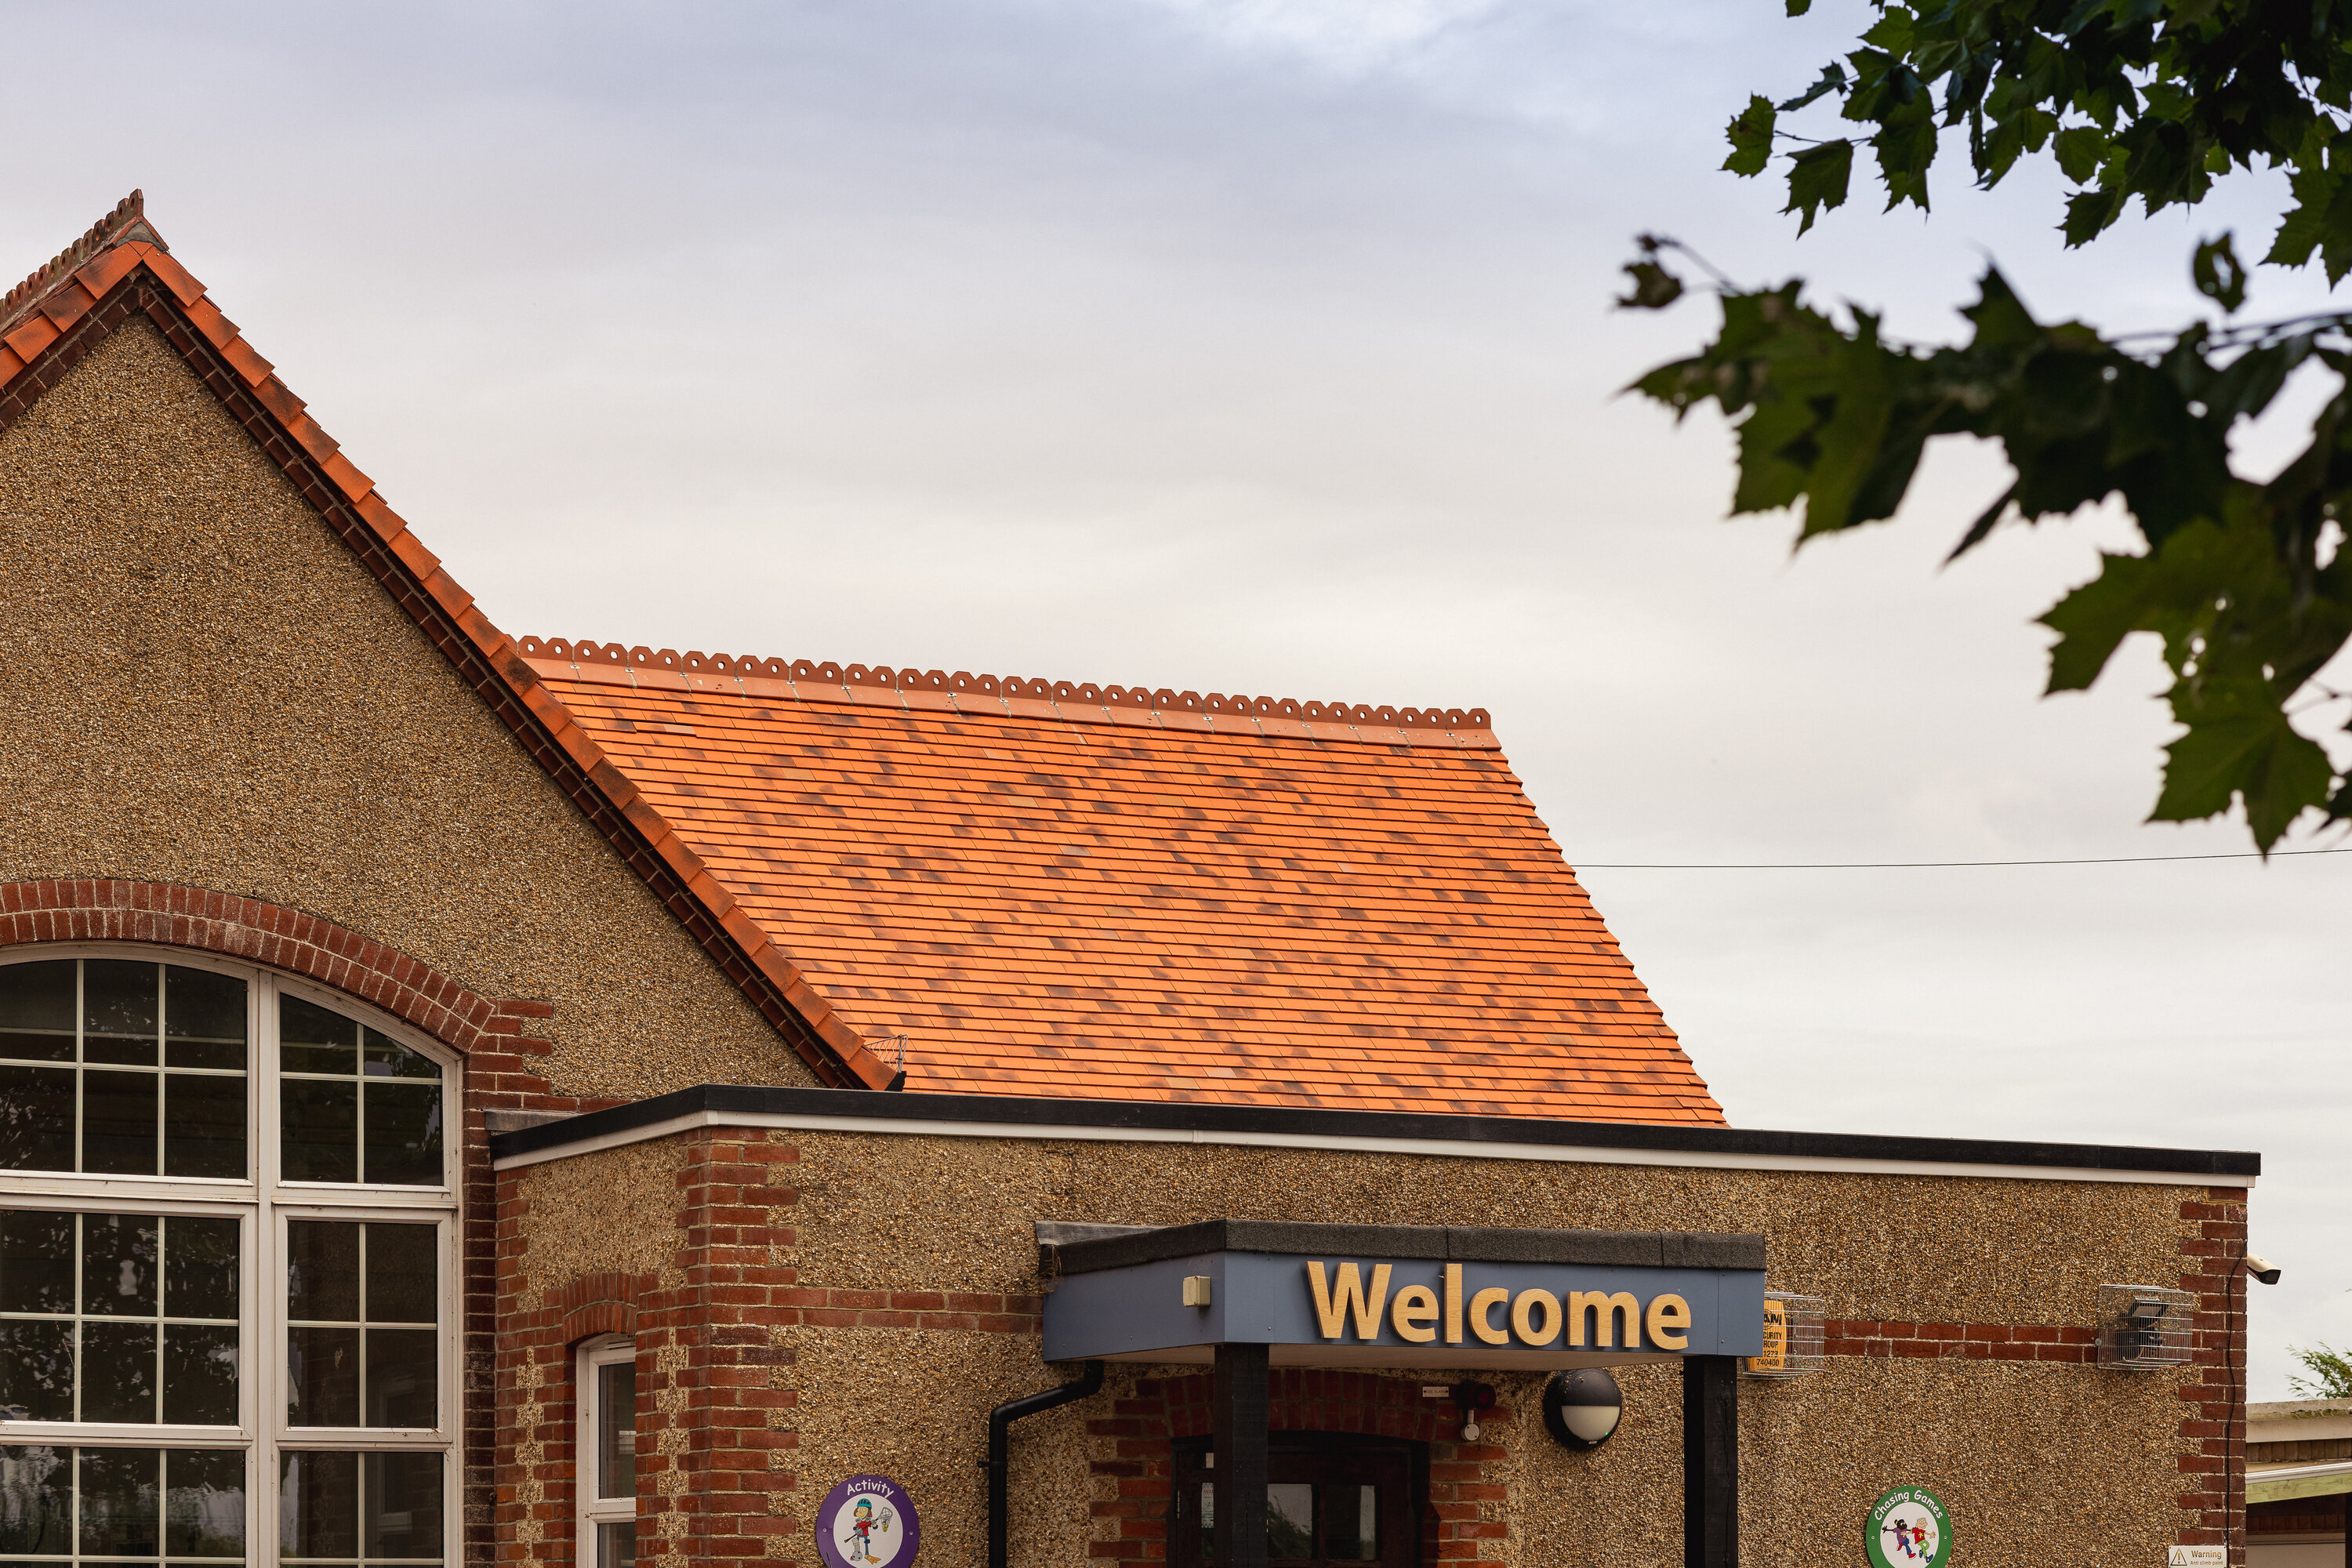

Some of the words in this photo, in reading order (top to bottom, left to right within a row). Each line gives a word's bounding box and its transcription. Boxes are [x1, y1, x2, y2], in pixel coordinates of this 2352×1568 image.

[1305, 1260, 1692, 1351] Welcome
[847, 1479, 894, 1498] Activity
[1875, 1491, 1910, 1520] Chasing
[1914, 1490, 1943, 1519] Games
[2191, 1551, 2222, 1559] Warning
